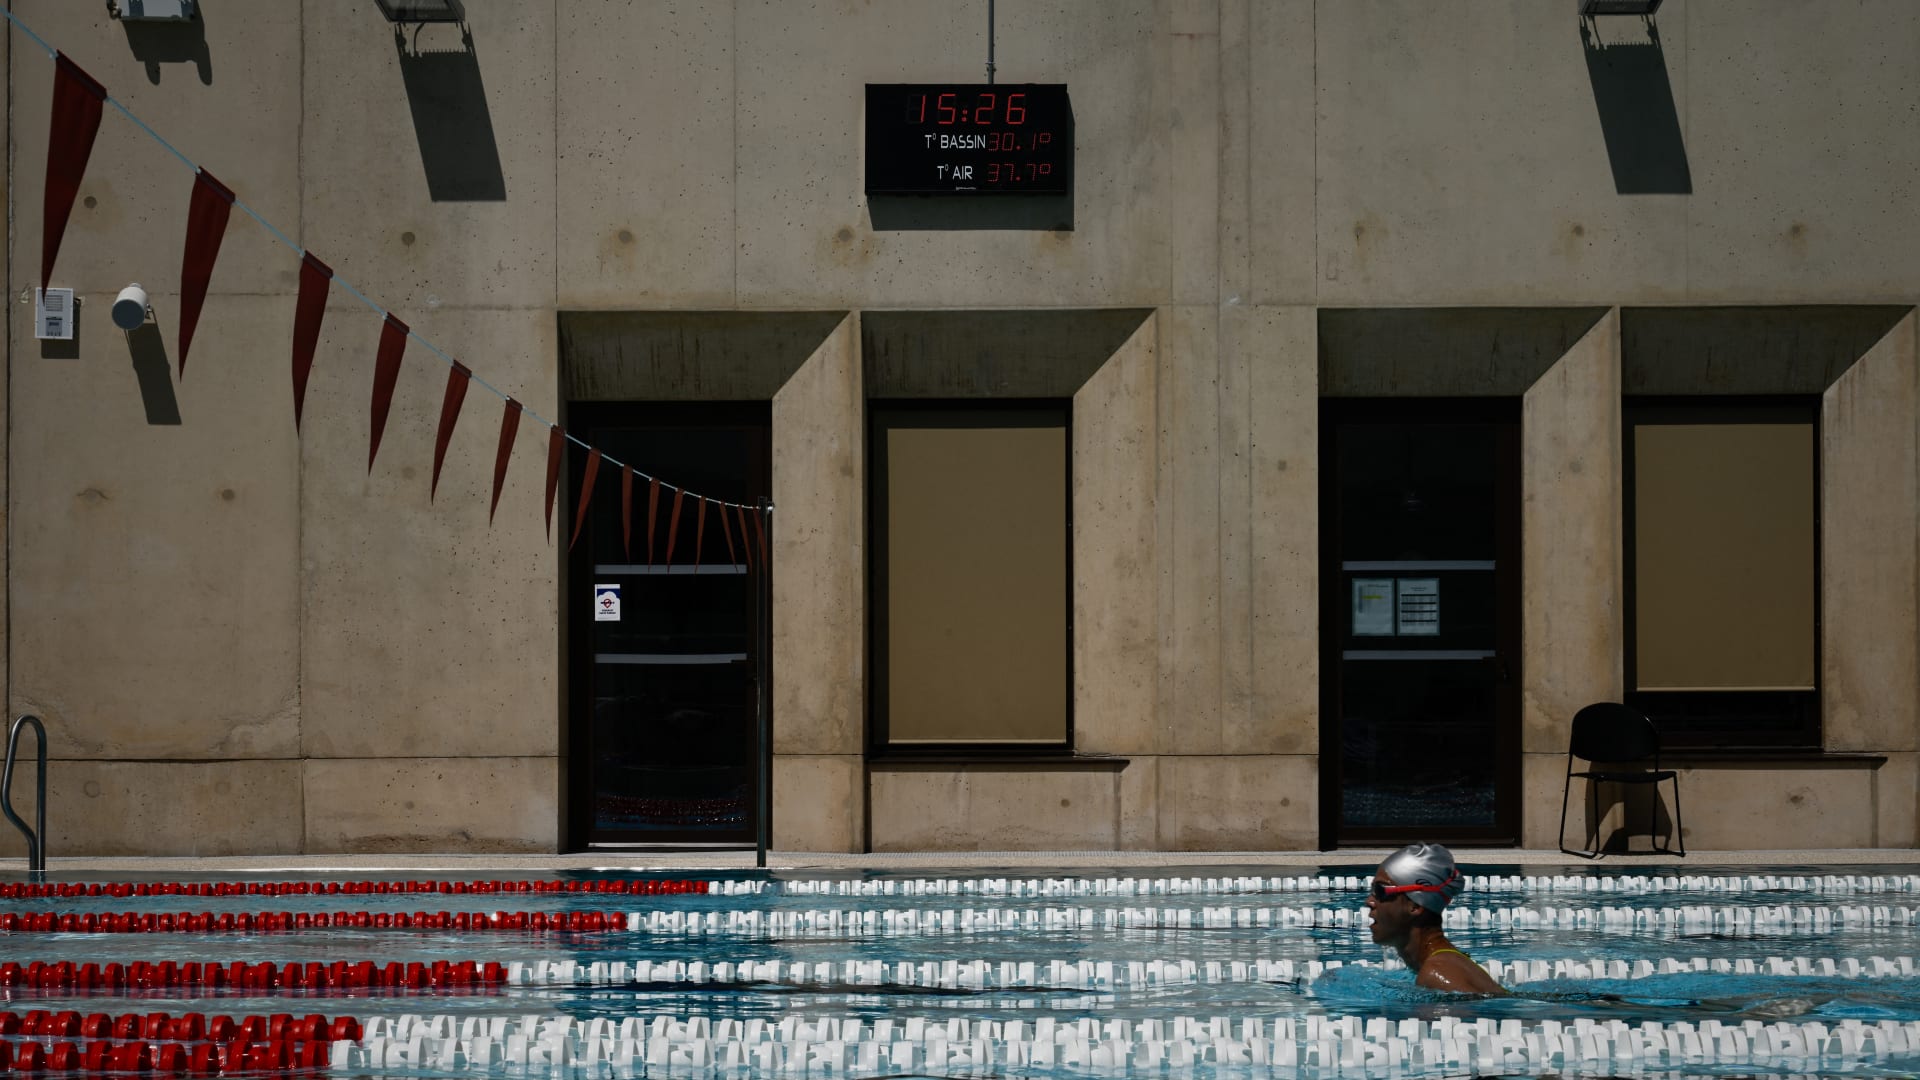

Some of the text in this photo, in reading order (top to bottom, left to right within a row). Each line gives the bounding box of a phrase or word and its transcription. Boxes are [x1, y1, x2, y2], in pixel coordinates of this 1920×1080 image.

[919, 93, 1026, 125] 15:26
[940, 134, 986, 149] BASSIN
[952, 165, 973, 180] AIR
